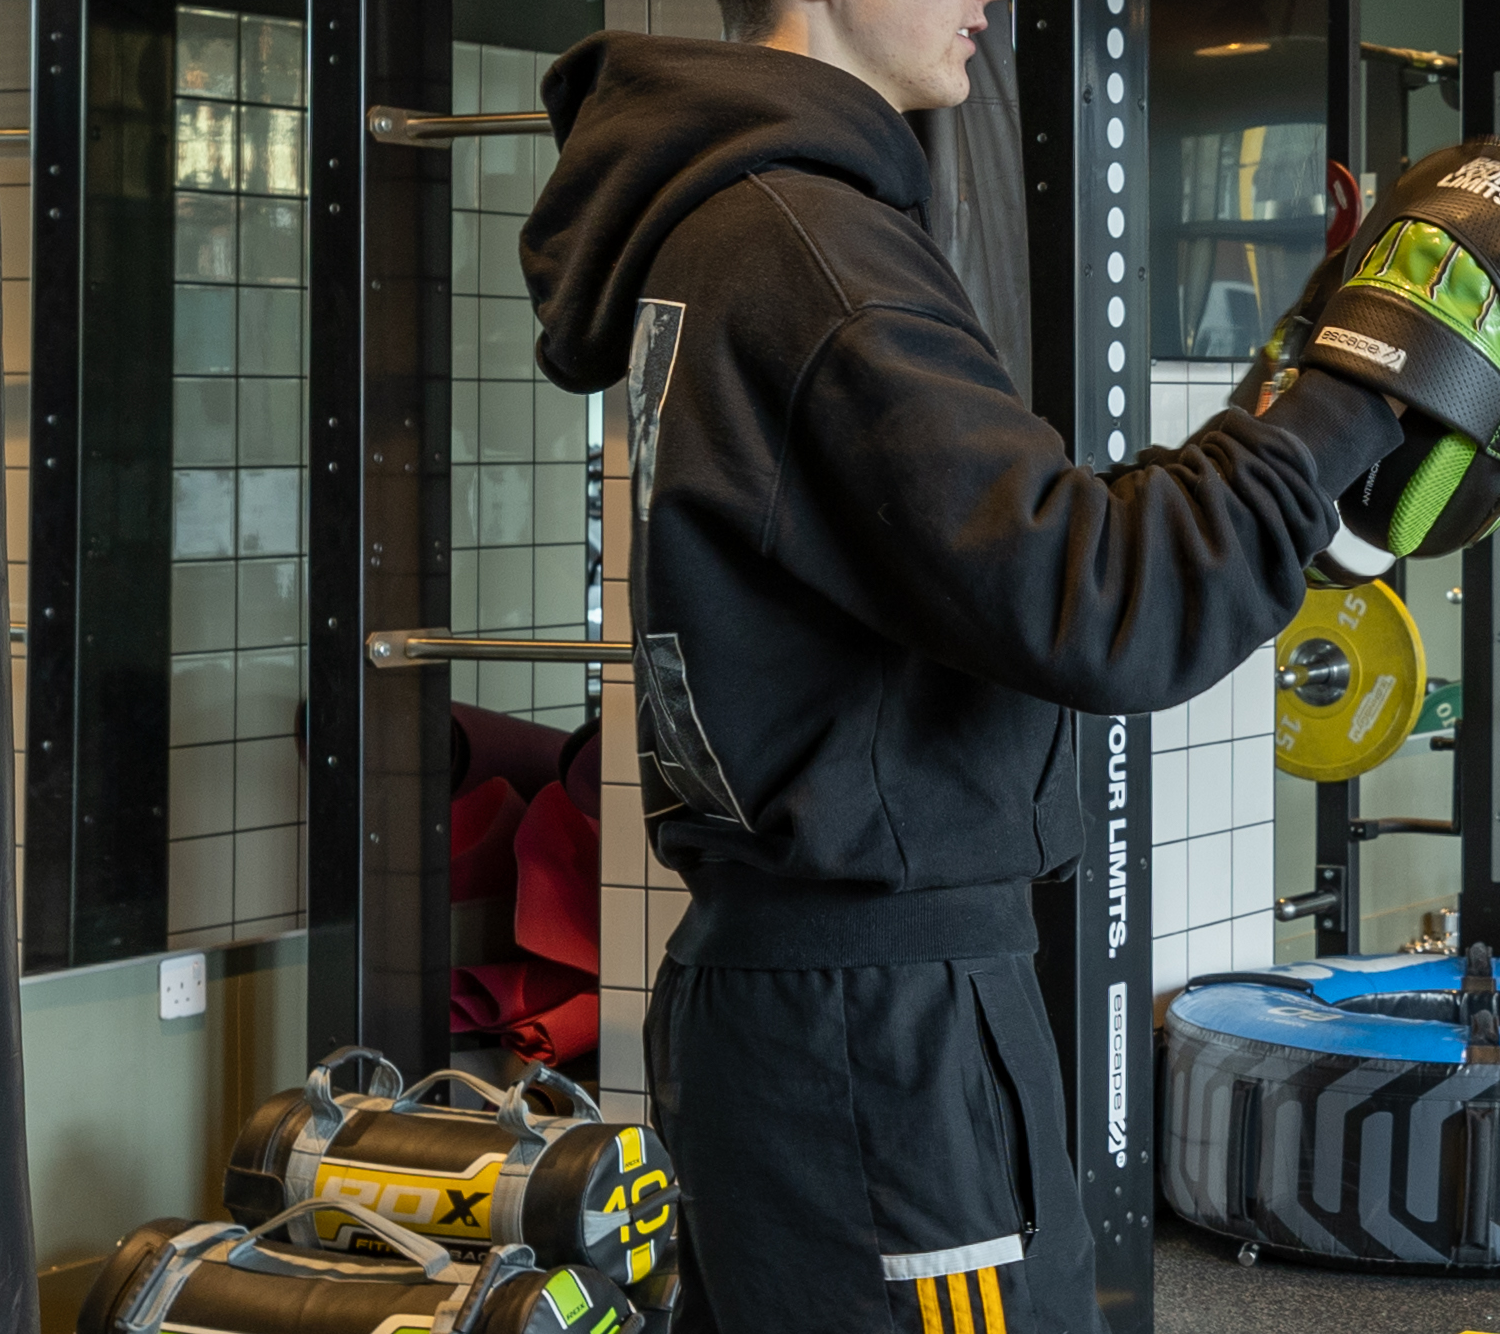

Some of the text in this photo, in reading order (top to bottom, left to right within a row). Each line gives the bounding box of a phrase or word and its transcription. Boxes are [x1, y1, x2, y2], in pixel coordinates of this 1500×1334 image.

[1321, 329, 1380, 355] escape
[1337, 593, 1368, 631] 15
[1275, 714, 1301, 752] 15
[1108, 817, 1128, 959] LIMITS.
[1112, 991, 1124, 1112] escape
[602, 1168, 670, 1244] 10
